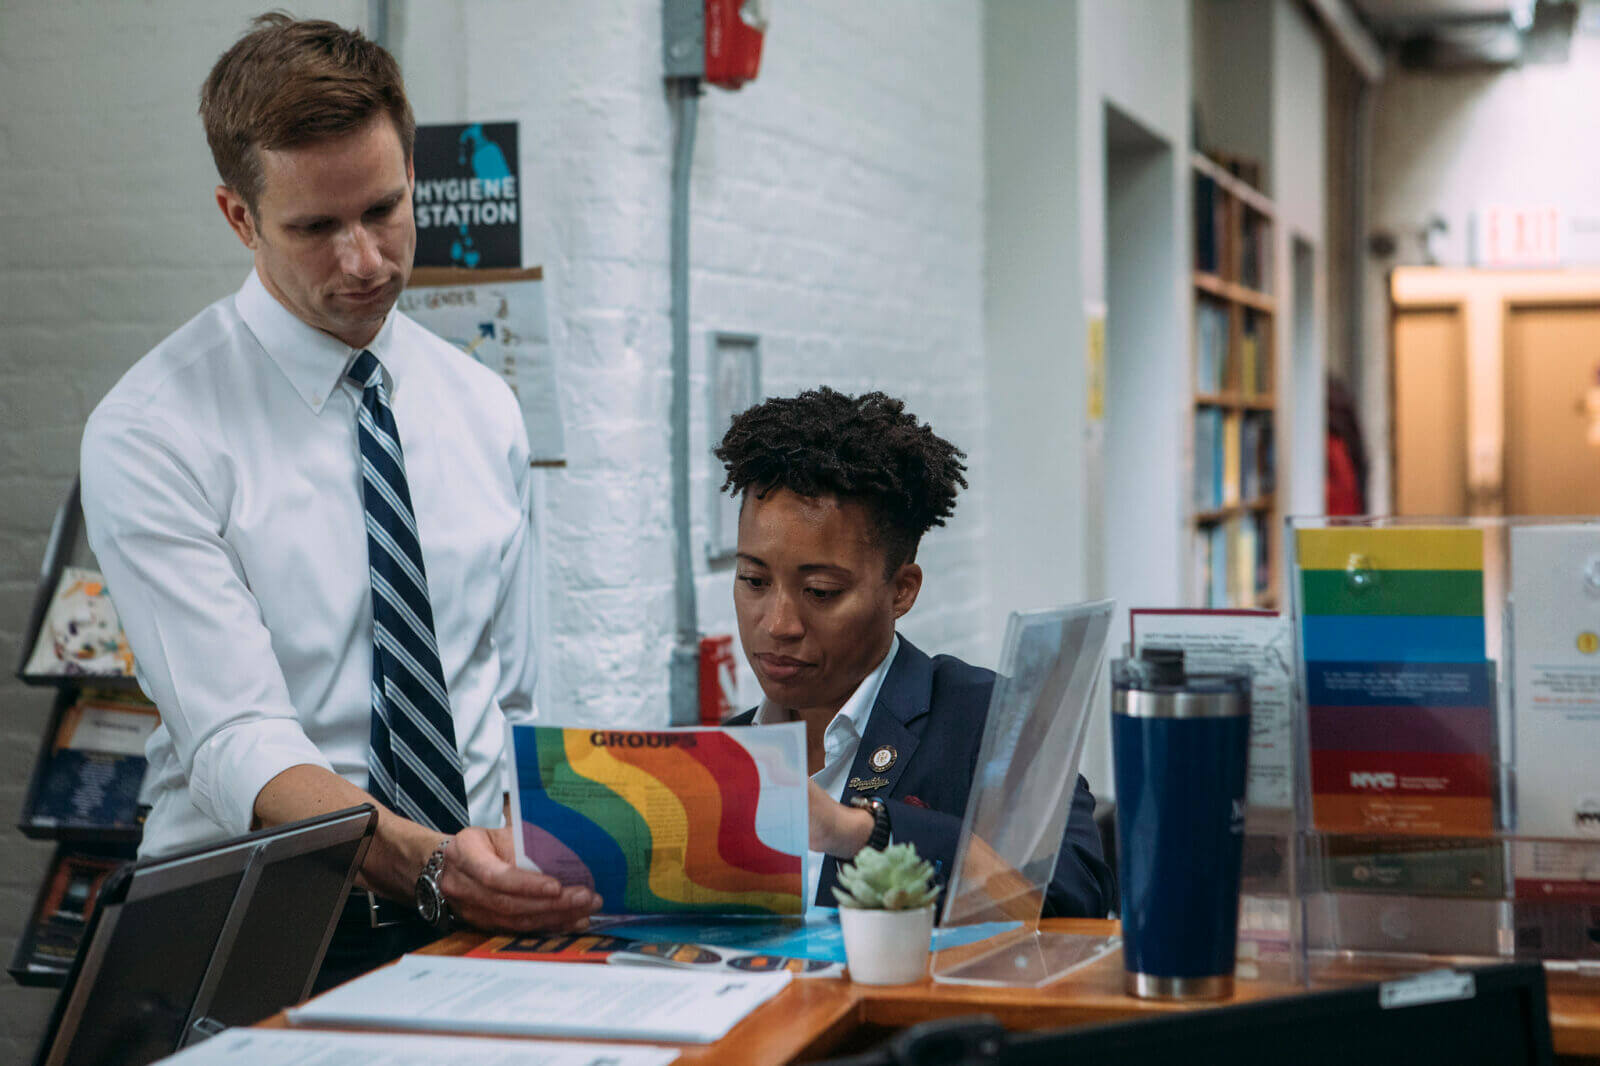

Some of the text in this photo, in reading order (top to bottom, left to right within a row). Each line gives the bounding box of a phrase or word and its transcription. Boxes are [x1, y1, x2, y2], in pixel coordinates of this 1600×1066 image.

[416, 178, 516, 202] HYGIENE
[417, 202, 517, 228] STATION
[589, 731, 697, 748] GROUPS
[1350, 772, 1397, 789] NYC
